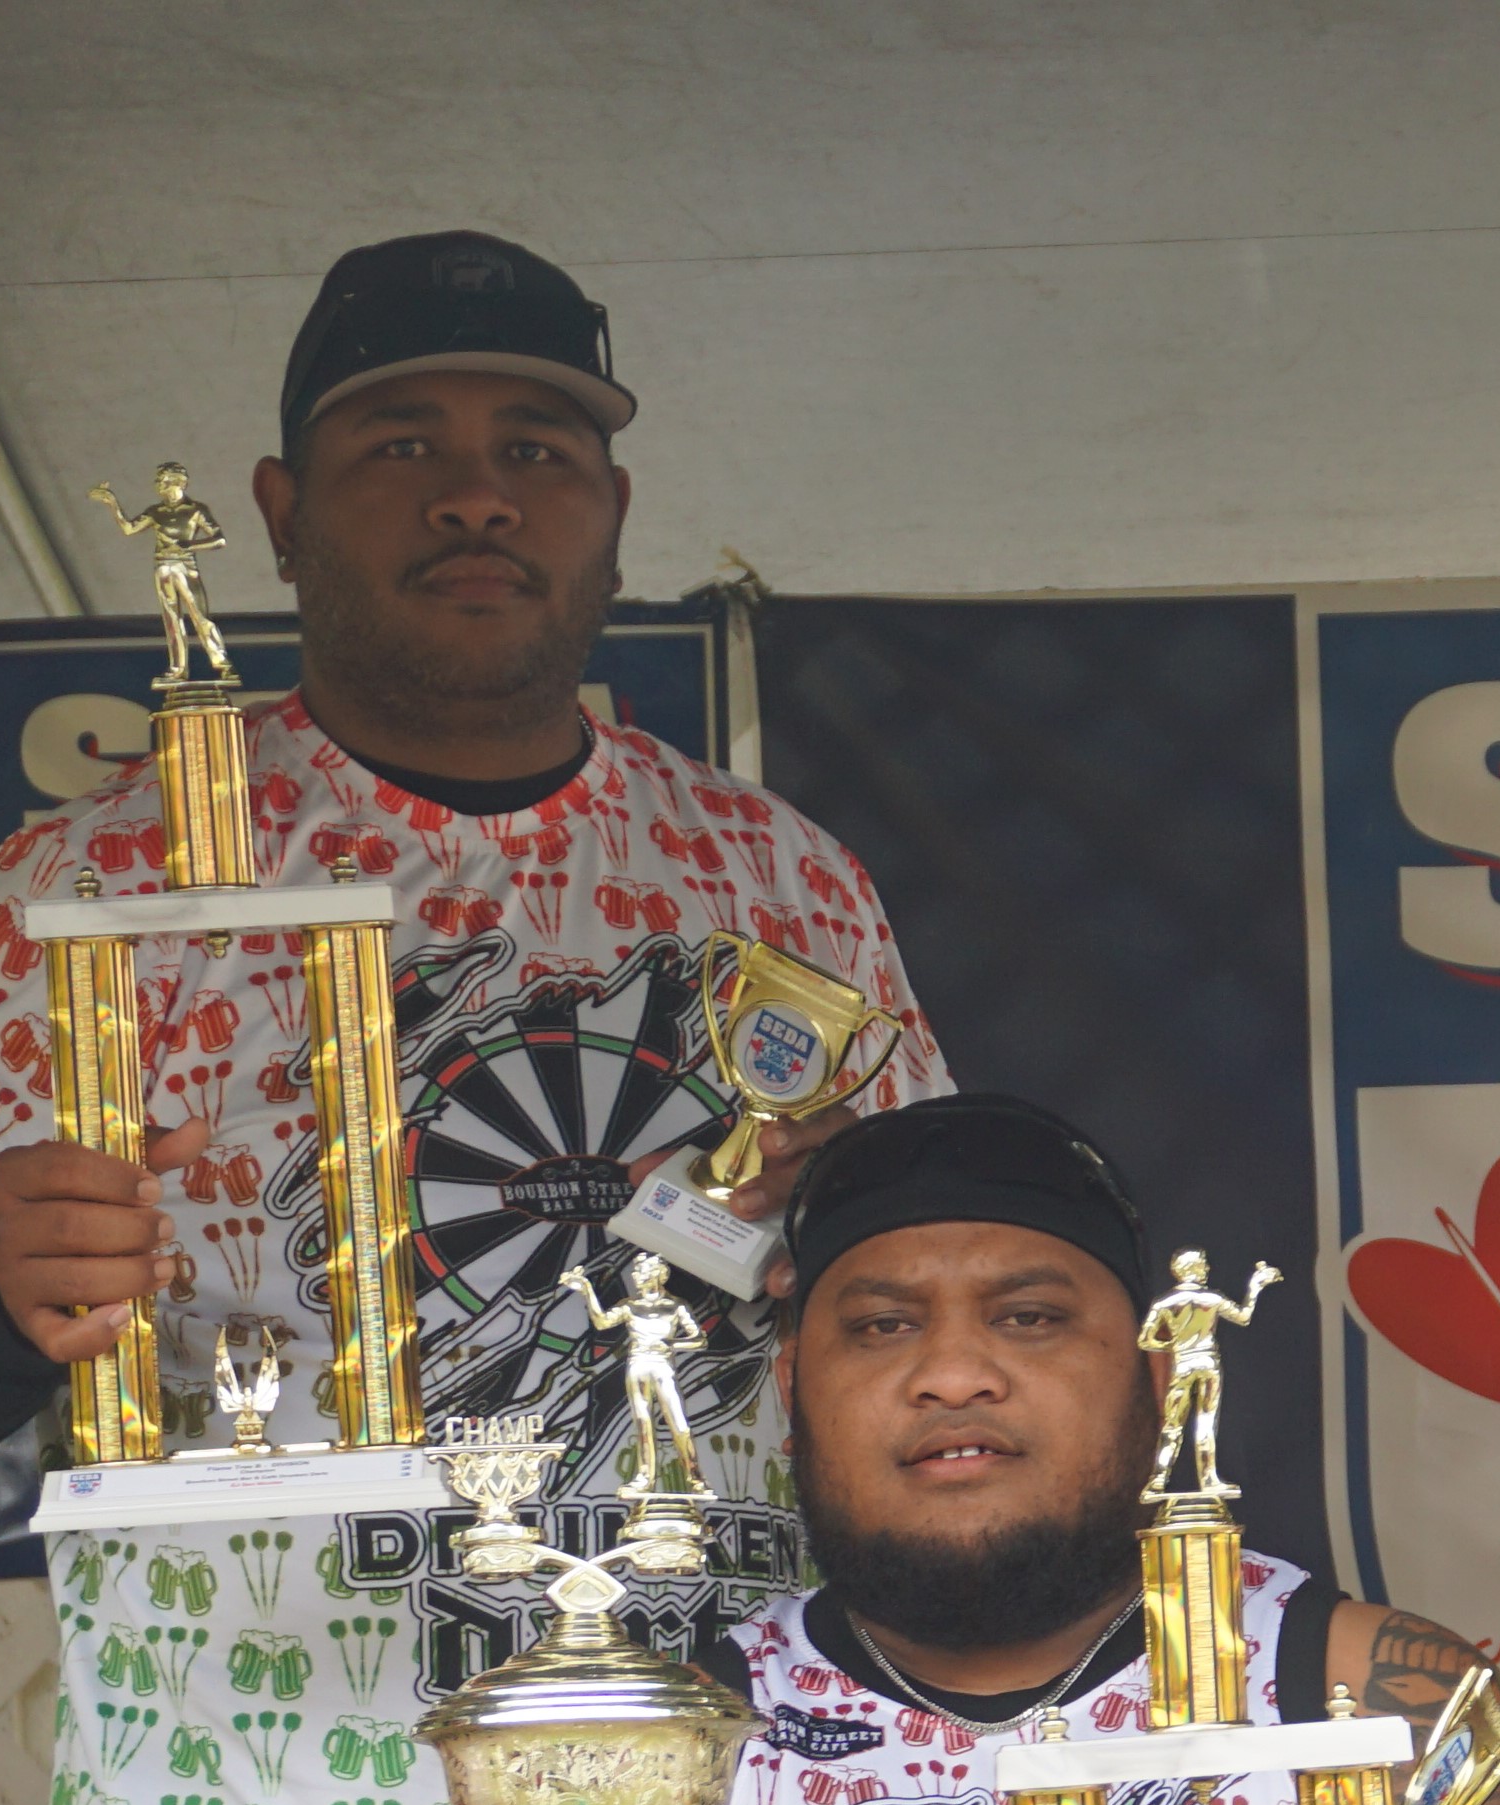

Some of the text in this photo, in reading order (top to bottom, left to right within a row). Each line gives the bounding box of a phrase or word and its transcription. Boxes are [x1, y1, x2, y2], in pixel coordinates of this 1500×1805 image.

[760, 1015, 809, 1052] SEDA
[502, 1180, 633, 1201] BOURBON STRE
[542, 1199, 575, 1213] BAR
[445, 1413, 545, 1446] CHAMP
[812, 1730, 881, 1742] STREET
[810, 1742, 849, 1752] CAFE
